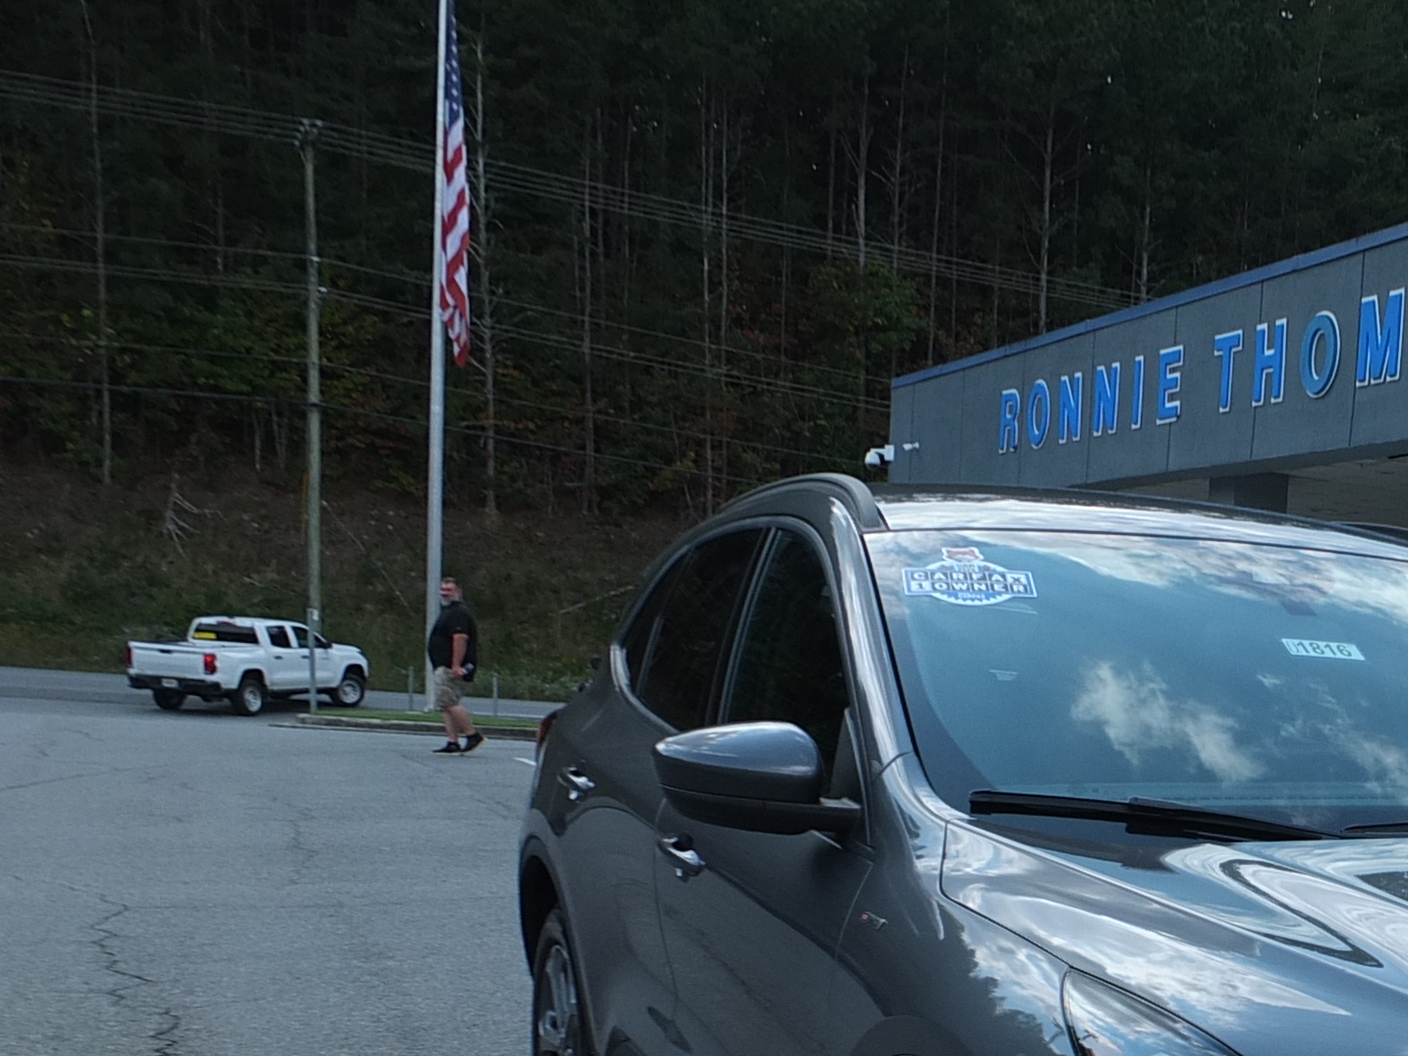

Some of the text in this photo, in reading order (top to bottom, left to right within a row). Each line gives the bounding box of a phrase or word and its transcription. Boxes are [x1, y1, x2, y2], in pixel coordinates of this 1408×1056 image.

[998, 344, 1184, 455] RONNIE
[913, 571, 1026, 584] CARFAX
[934, 582, 1026, 593] OWNER
